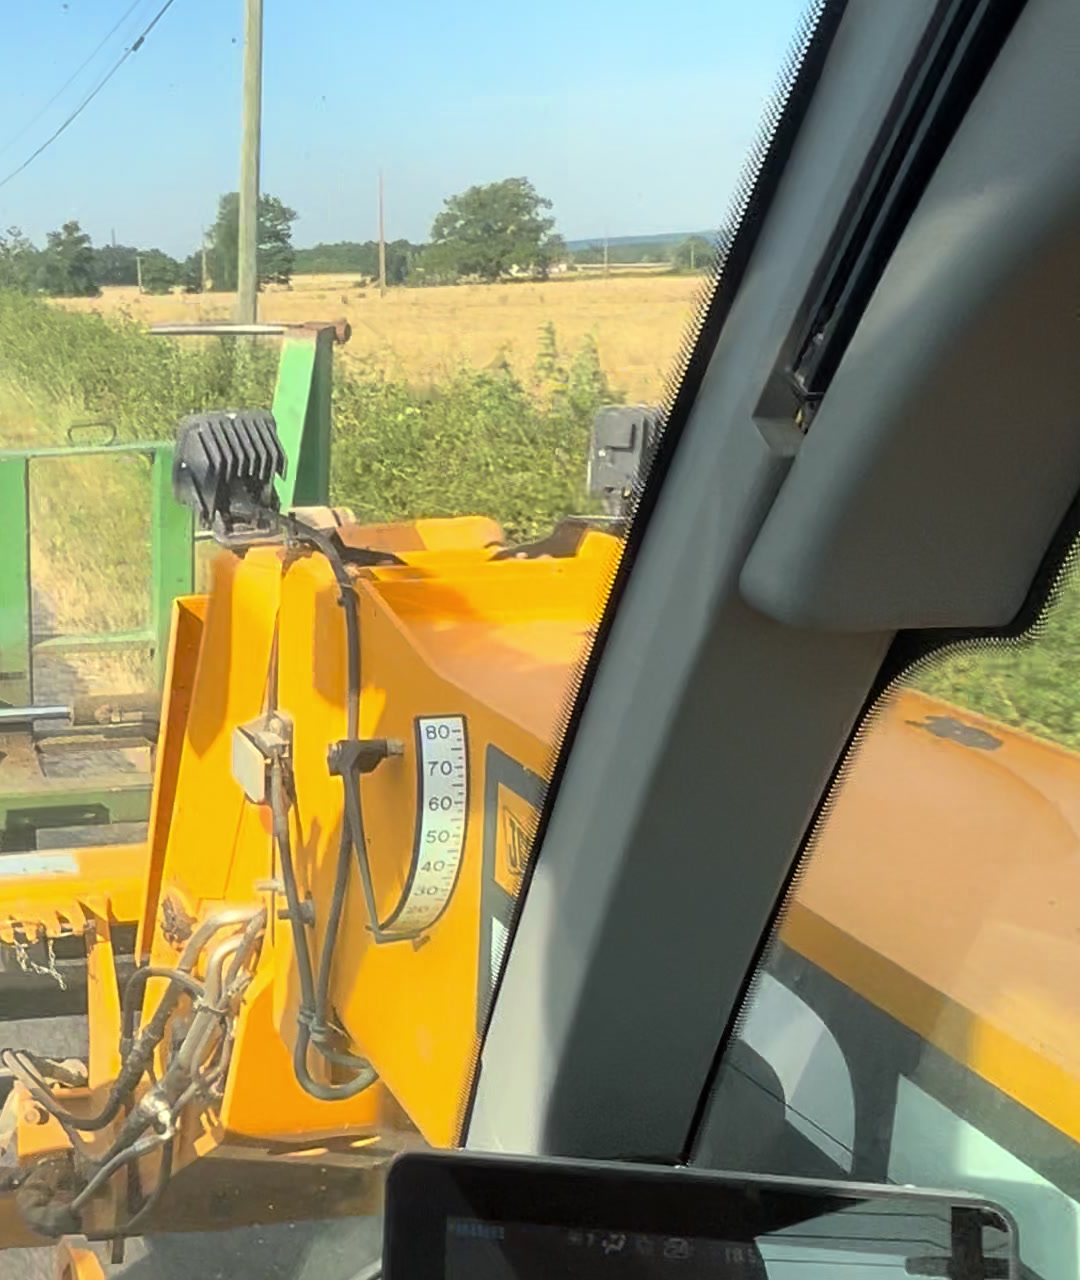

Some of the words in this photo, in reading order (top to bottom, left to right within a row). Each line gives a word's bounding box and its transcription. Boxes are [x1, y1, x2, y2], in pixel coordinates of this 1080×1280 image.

[425, 724, 450, 740] 80
[427, 760, 453, 777] 70
[428, 795, 453, 811] 60
[425, 829, 450, 844] 50
[420, 860, 446, 873] 40
[412, 885, 439, 897] 30
